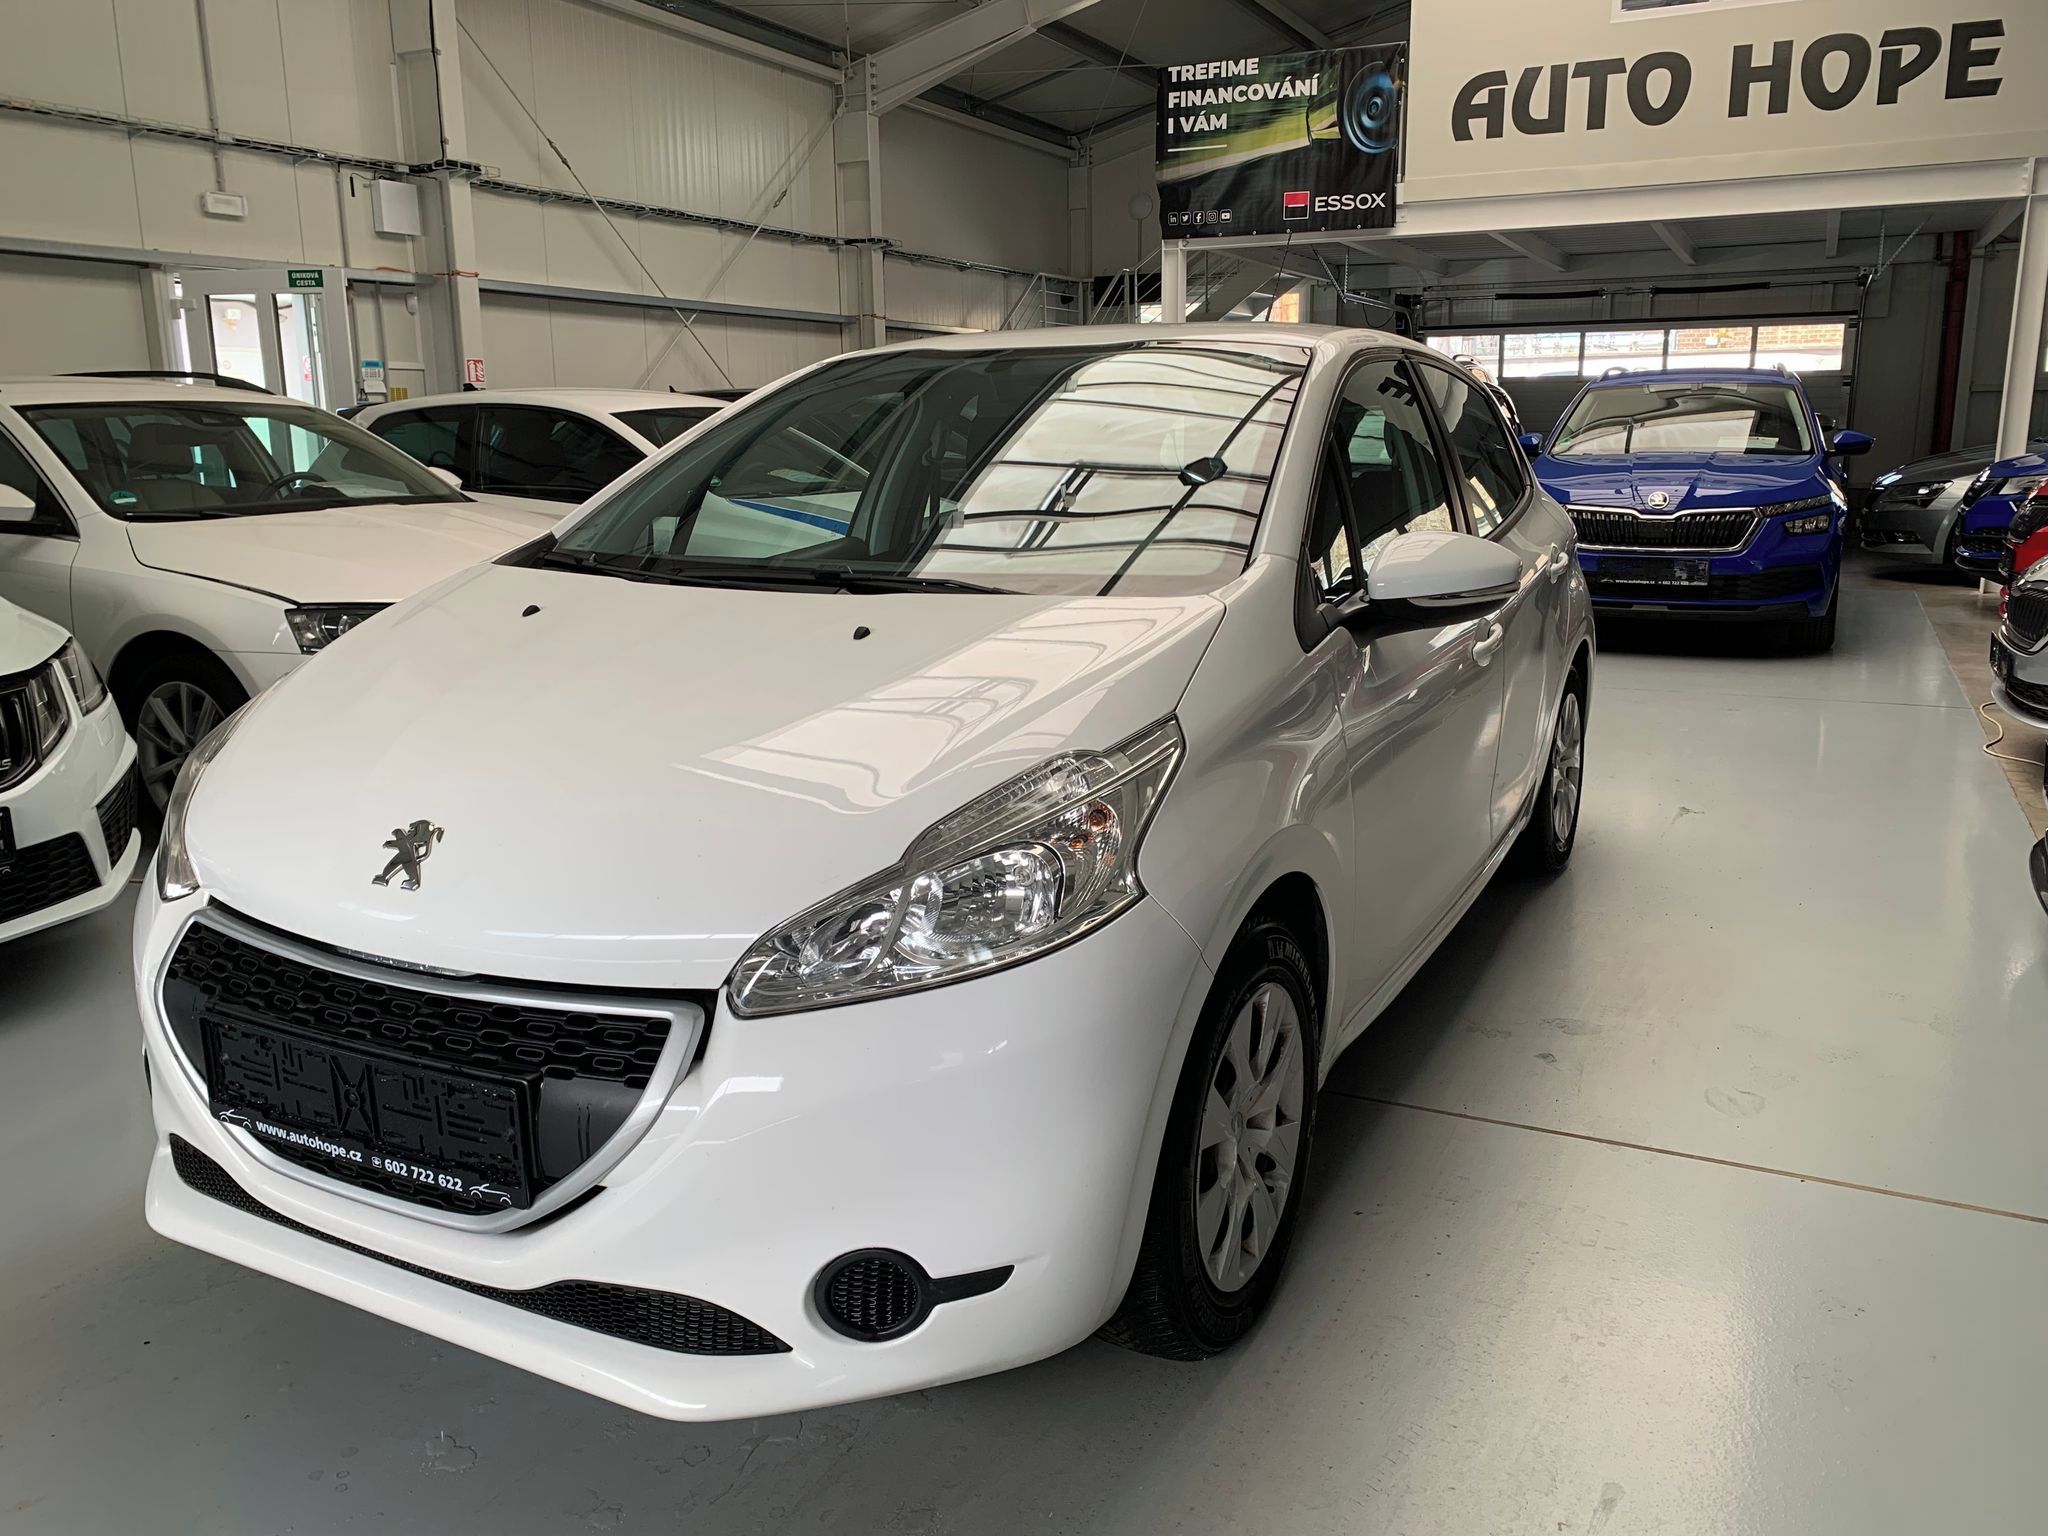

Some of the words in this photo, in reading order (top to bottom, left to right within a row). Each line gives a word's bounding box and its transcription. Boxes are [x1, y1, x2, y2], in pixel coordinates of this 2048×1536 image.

[1168, 57, 1260, 83] TREFIME
[1451, 51, 1692, 142] AUTO
[1727, 18, 2006, 119] HOPE
[1168, 73, 1320, 109] FINANCOVÁNÍ
[1167, 117, 1174, 134] I
[1180, 110, 1228, 133] VÁM
[1314, 192, 1387, 212] ESSOX
[255, 1120, 363, 1163] www.autohope.cz
[384, 1158, 408, 1177] 602
[410, 1166, 435, 1184] 722
[438, 1173, 463, 1192] 622
